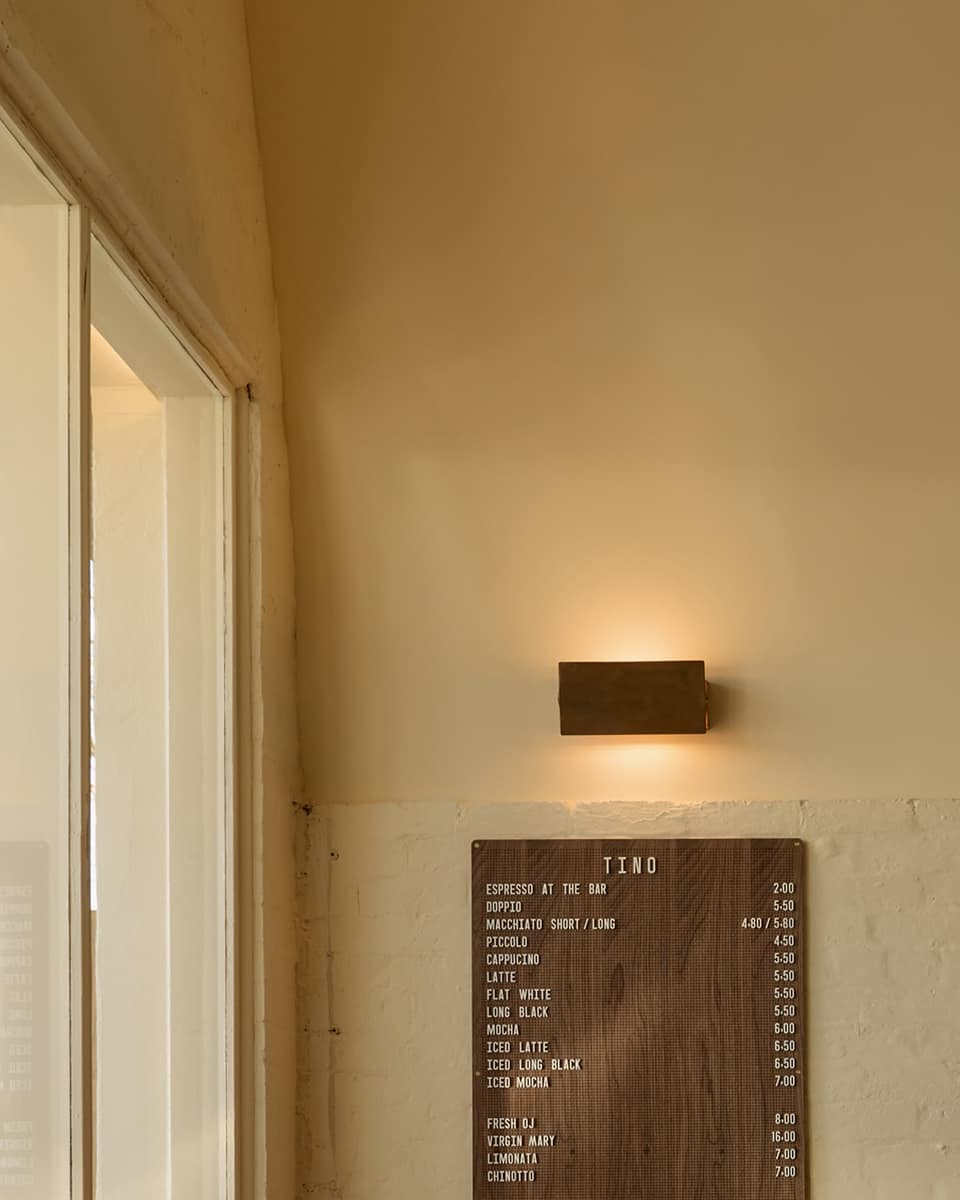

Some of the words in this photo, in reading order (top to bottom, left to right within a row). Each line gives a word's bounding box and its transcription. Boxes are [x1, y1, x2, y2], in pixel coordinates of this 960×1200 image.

[604, 857, 658, 874] TINO
[486, 883, 534, 895] ESPRESSO
[542, 883, 554, 895] AT
[563, 883, 580, 895] THE
[589, 883, 607, 895] BAR
[773, 882, 794, 894] 2.00
[486, 901, 521, 913] DOPPIO
[774, 899, 794, 911] 5.50
[486, 918, 543, 930] MACCHIATO
[551, 918, 580, 930] SHORT
[592, 918, 616, 930] LONG
[742, 917, 762, 929] 4.80
[774, 917, 794, 929] 5.80
[486, 936, 528, 948] PICCOLO
[774, 934, 794, 946] 4.50
[486, 953, 540, 965] CAPPUCINO
[774, 952, 794, 964] 5.50
[486, 971, 516, 983] LATTE
[774, 970, 795, 982] 5.50
[486, 988, 510, 1000] FLAT
[519, 988, 551, 1000] WHITE
[774, 987, 795, 999] 5.50
[486, 1006, 510, 1018] LONG
[519, 1006, 549, 1018] BLACK
[774, 1005, 795, 1017] 5.50
[487, 1024, 519, 1036] MOCHA
[774, 1022, 795, 1034] 6.00
[487, 1041, 510, 1053] ICED
[519, 1041, 549, 1053] LATTE
[775, 1040, 795, 1052] 6.50
[487, 1059, 510, 1071] ICED
[519, 1059, 543, 1071] LONG
[551, 1059, 582, 1071] BLACK
[775, 1057, 795, 1069] 6.50
[487, 1077, 510, 1088] ICED
[516, 1077, 549, 1088] MOCHA
[775, 1075, 795, 1087] 7.00
[487, 1117, 516, 1129] FRESH
[522, 1117, 535, 1129] OJ
[775, 1113, 796, 1125] 8.00
[487, 1135, 522, 1147] VIRGIN
[528, 1135, 556, 1147] MARY
[772, 1131, 796, 1142] 16.00
[487, 1153, 537, 1164] LIMONATA
[775, 1148, 796, 1160] 7.00
[487, 1170, 535, 1182] CHINOTTO
[775, 1166, 796, 1178] 7.00
